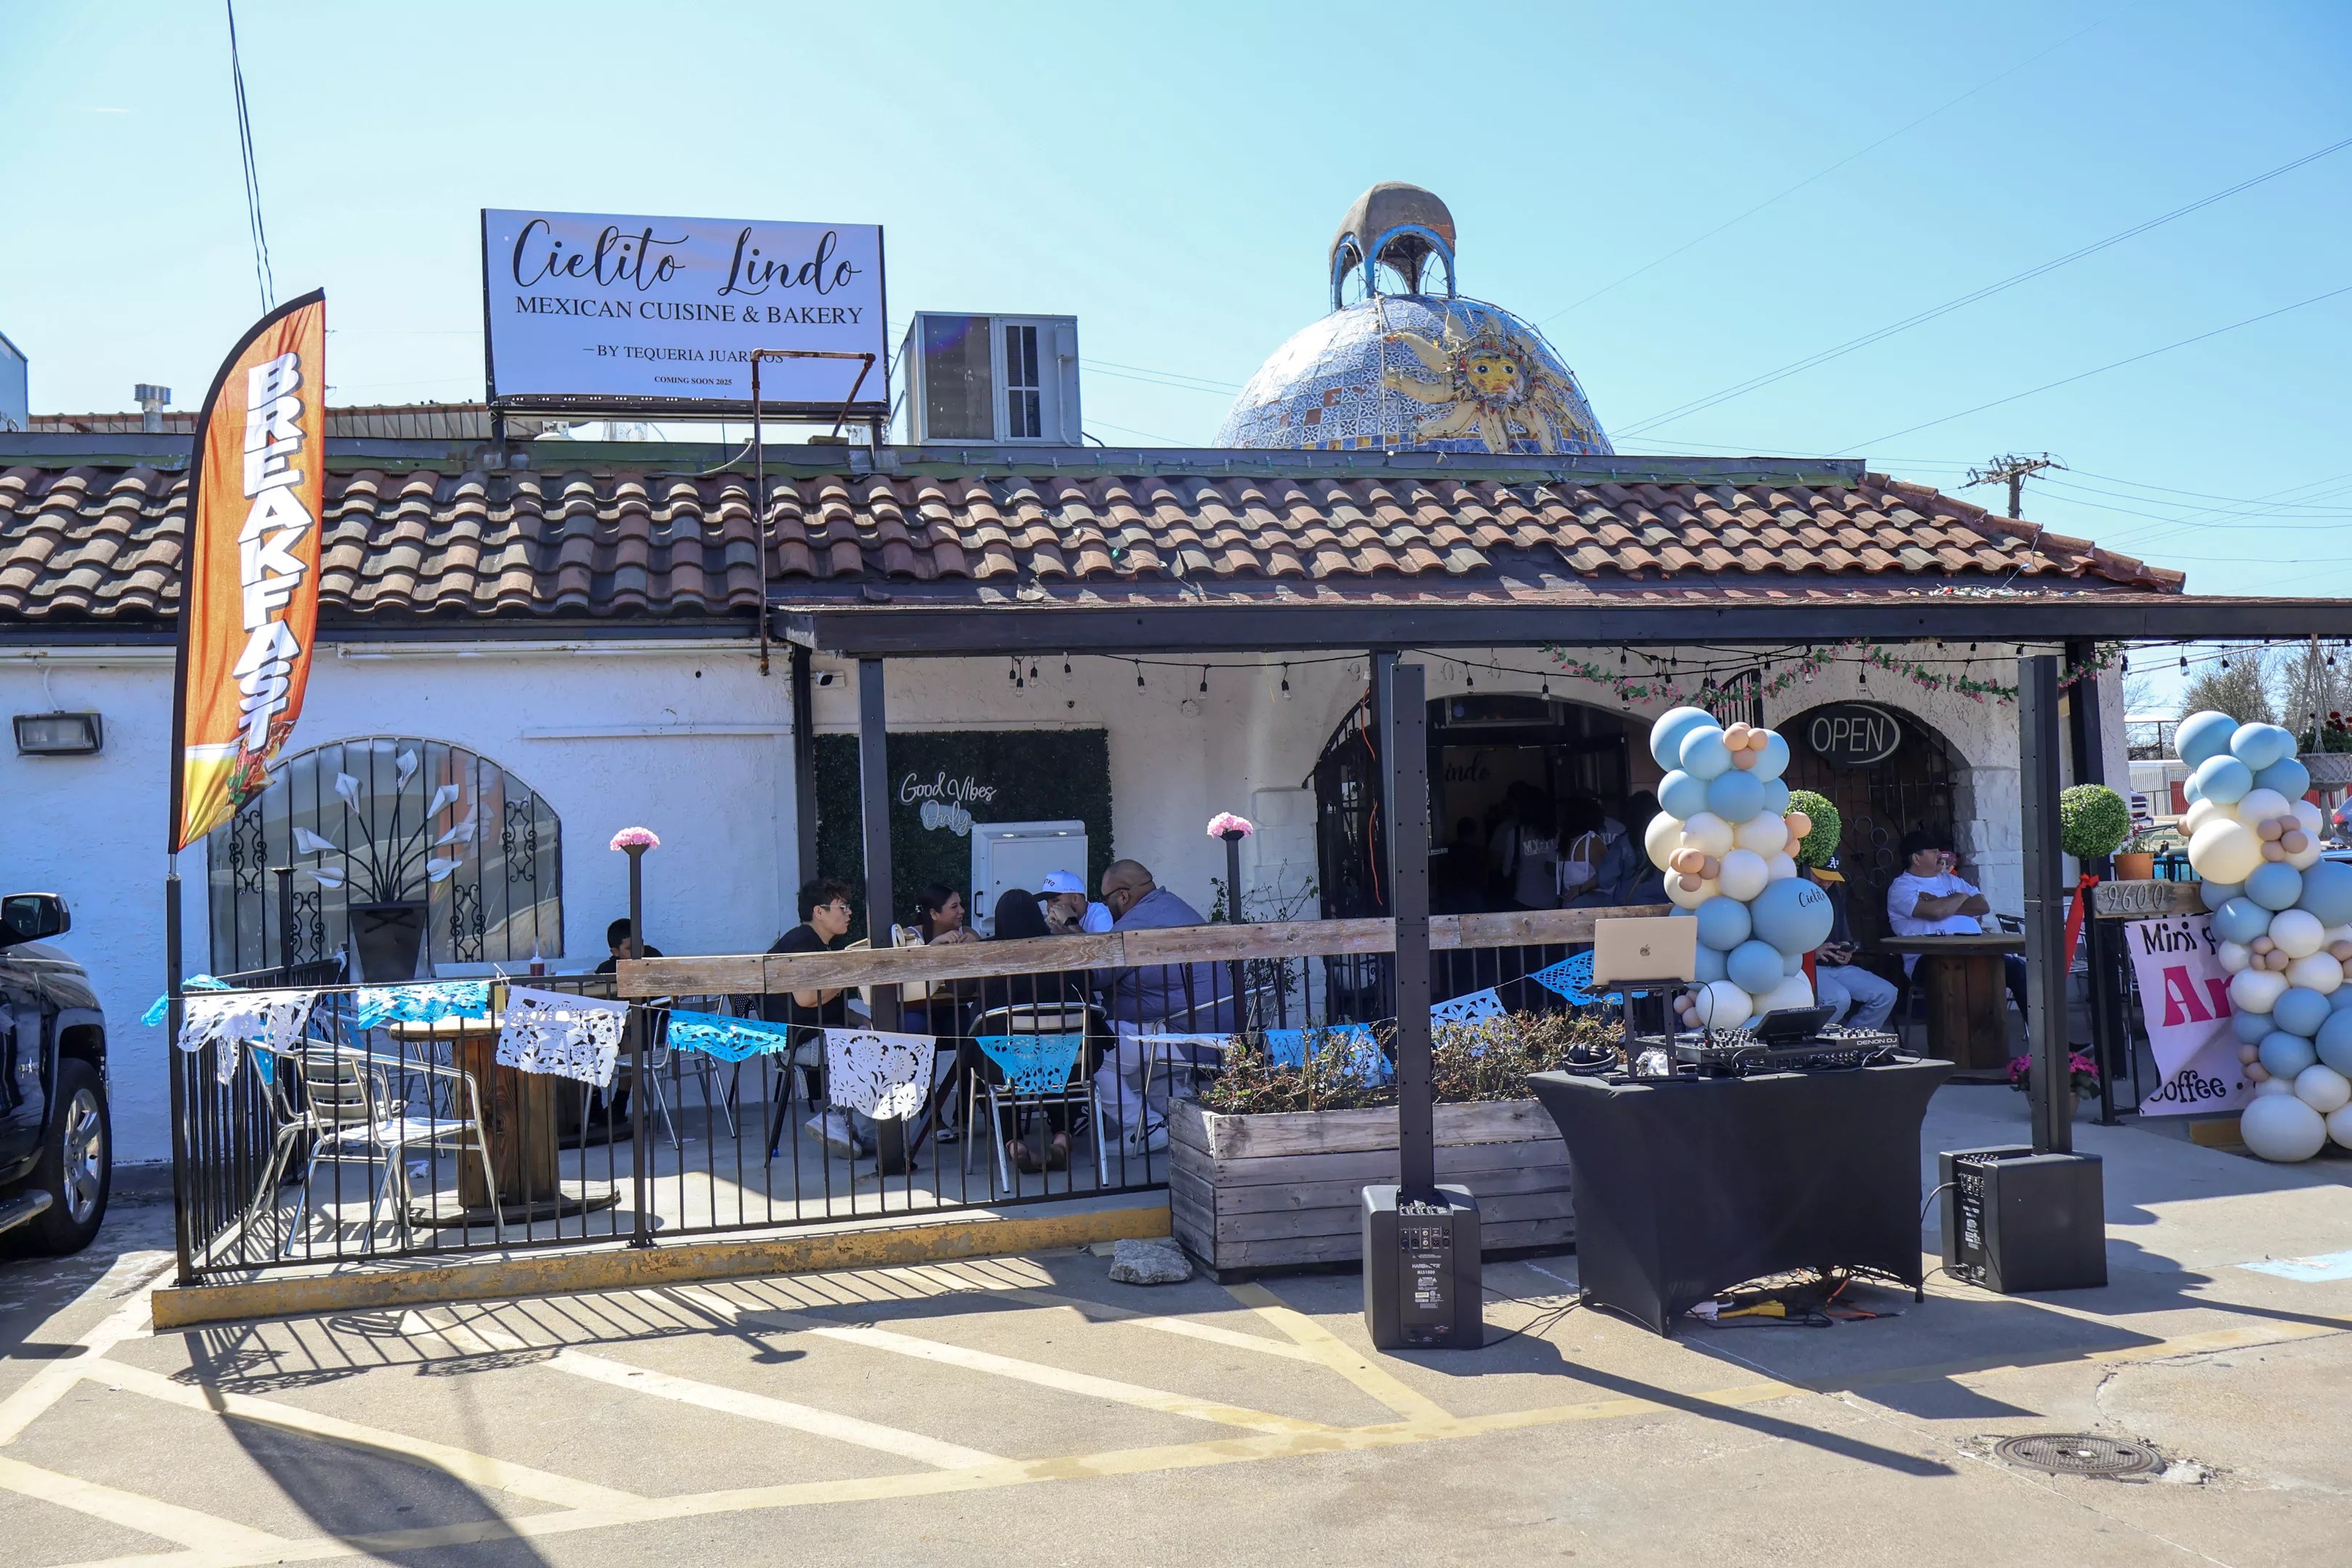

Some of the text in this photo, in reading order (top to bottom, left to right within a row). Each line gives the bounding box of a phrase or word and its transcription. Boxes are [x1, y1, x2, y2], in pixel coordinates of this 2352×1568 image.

[513, 219, 863, 297] Cielito Lindo
[516, 295, 863, 324] MEXICAN CUISINE & BAKERY
[623, 346, 704, 362] TEQUERIA
[233, 351, 314, 754] BREAKFAST
[1812, 717, 1884, 752] OPEN
[1444, 751, 1490, 783] indo
[900, 772, 997, 803] Good Vibes
[924, 799, 969, 833] Only
[2107, 883, 2164, 911] 9600
[2140, 921, 2197, 955] Mini
[2162, 965, 2235, 1027] Ar
